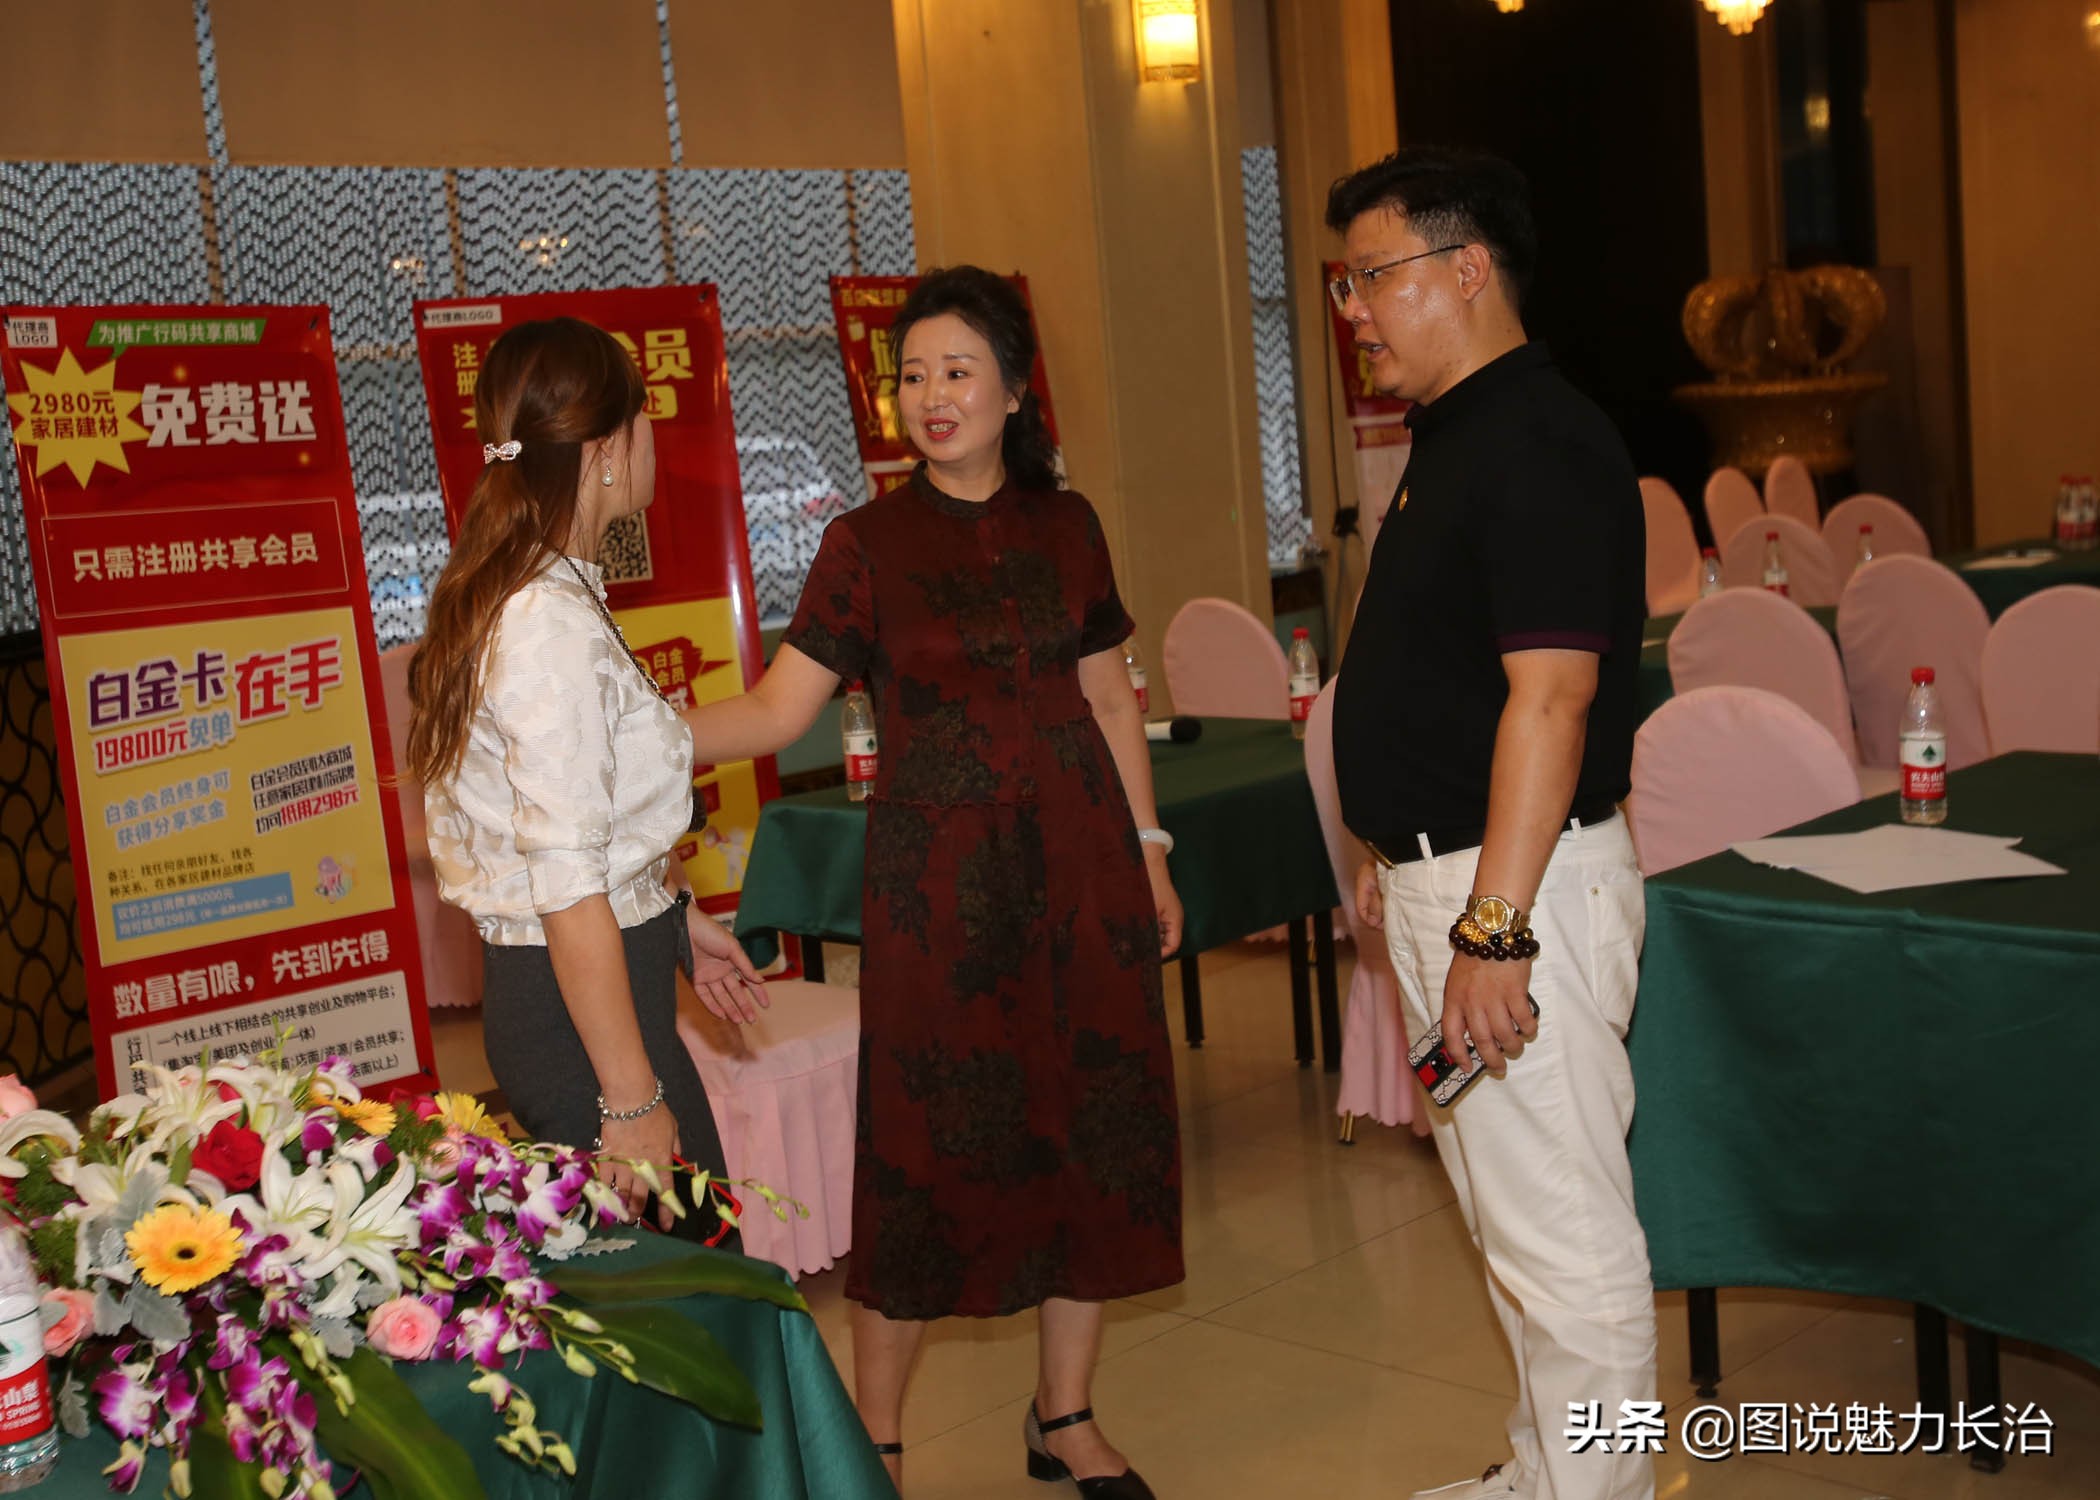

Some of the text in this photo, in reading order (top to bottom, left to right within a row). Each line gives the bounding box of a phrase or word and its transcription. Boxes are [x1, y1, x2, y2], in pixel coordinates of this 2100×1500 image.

[13, 321, 48, 333] 代理商
[15, 334, 49, 345] LOGO
[99, 321, 257, 344] 为推广行码共享商城
[29, 391, 115, 415] 2980元
[141, 380, 317, 448] 免费送
[31, 415, 119, 440] 家居建材
[73, 532, 319, 583] 只需注册共享会员
[105, 771, 229, 826] 白金会员终身可
[116, 799, 225, 849] 获得分享奖金
[113, 930, 390, 1020] 数量有限，先到先得
